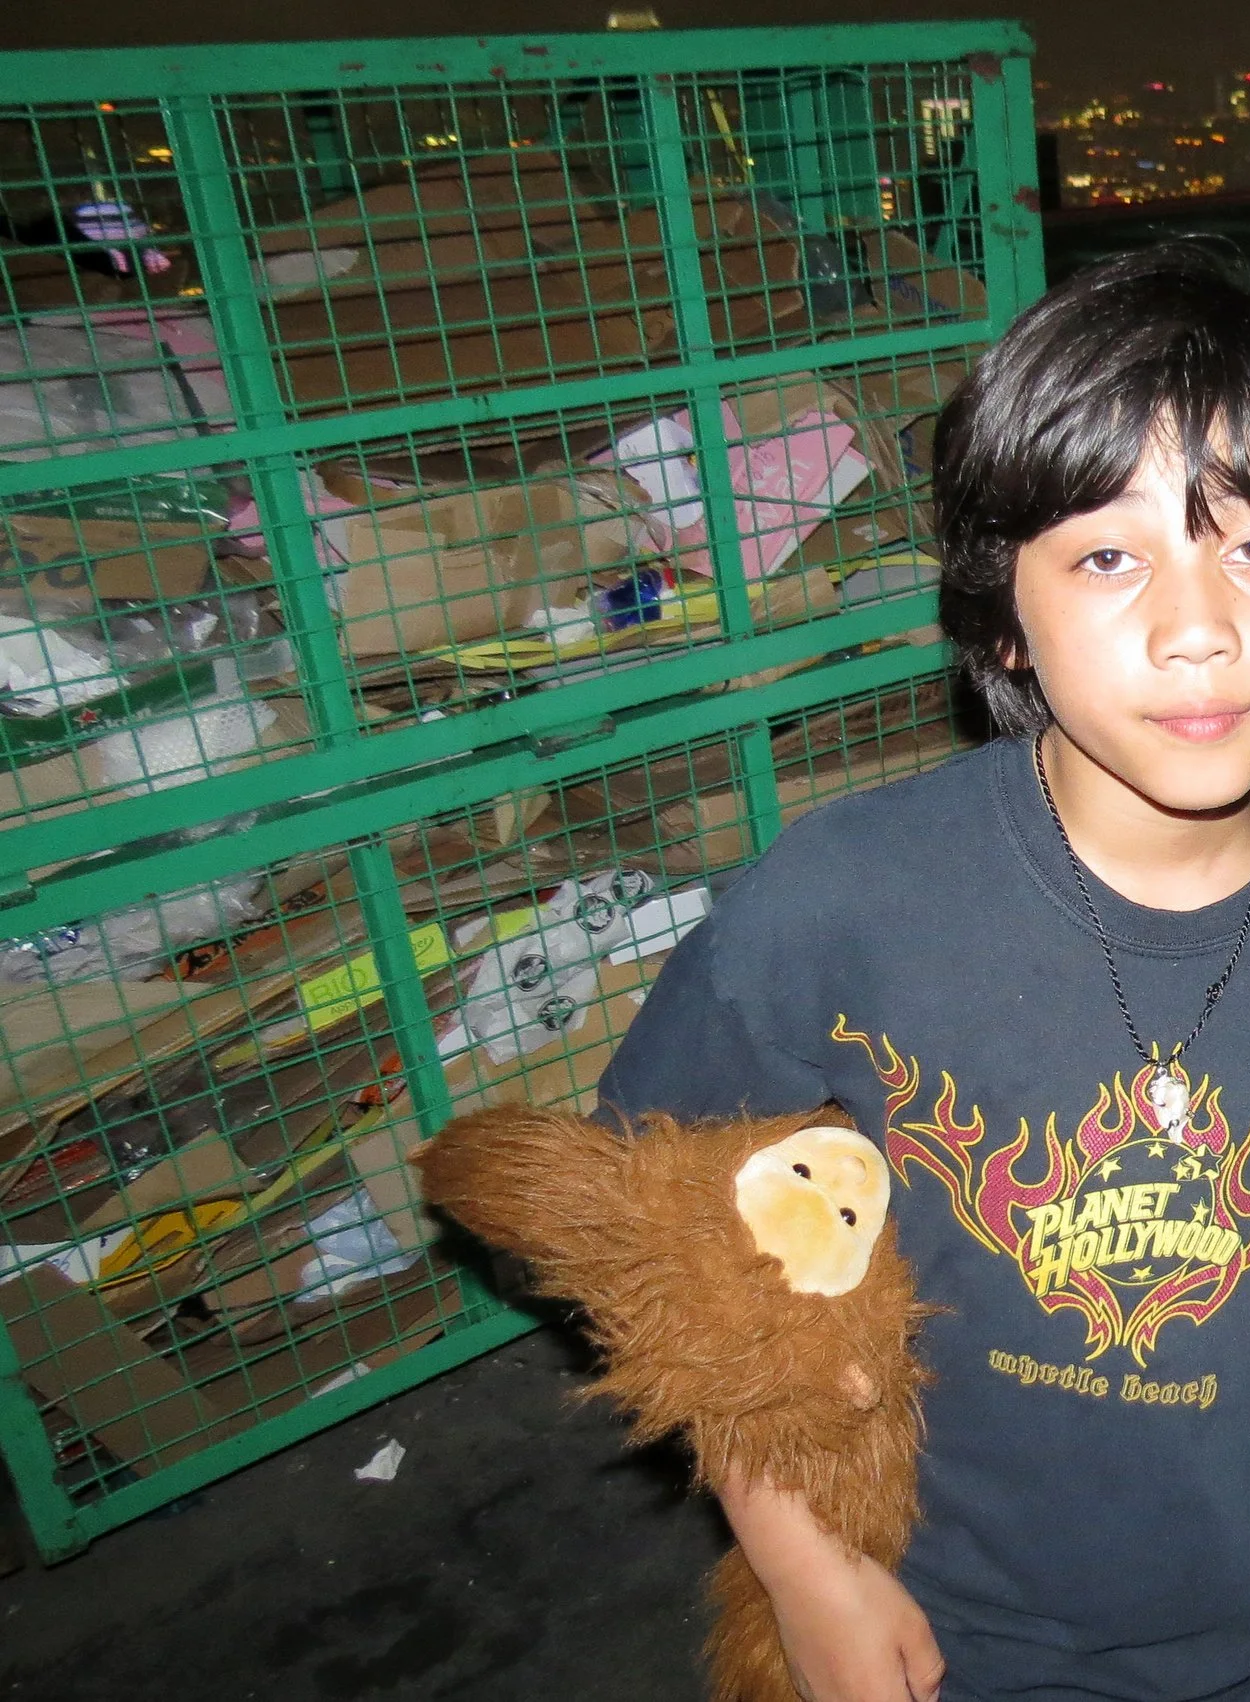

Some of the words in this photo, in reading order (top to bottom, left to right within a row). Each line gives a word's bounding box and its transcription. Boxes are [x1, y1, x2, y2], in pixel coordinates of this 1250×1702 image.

[1025, 1183, 1181, 1262] PLANET
[1026, 1220, 1243, 1299] HOLLYWOOD
[988, 1349, 1109, 1395] myrtle
[1120, 1373, 1218, 1410] beach
